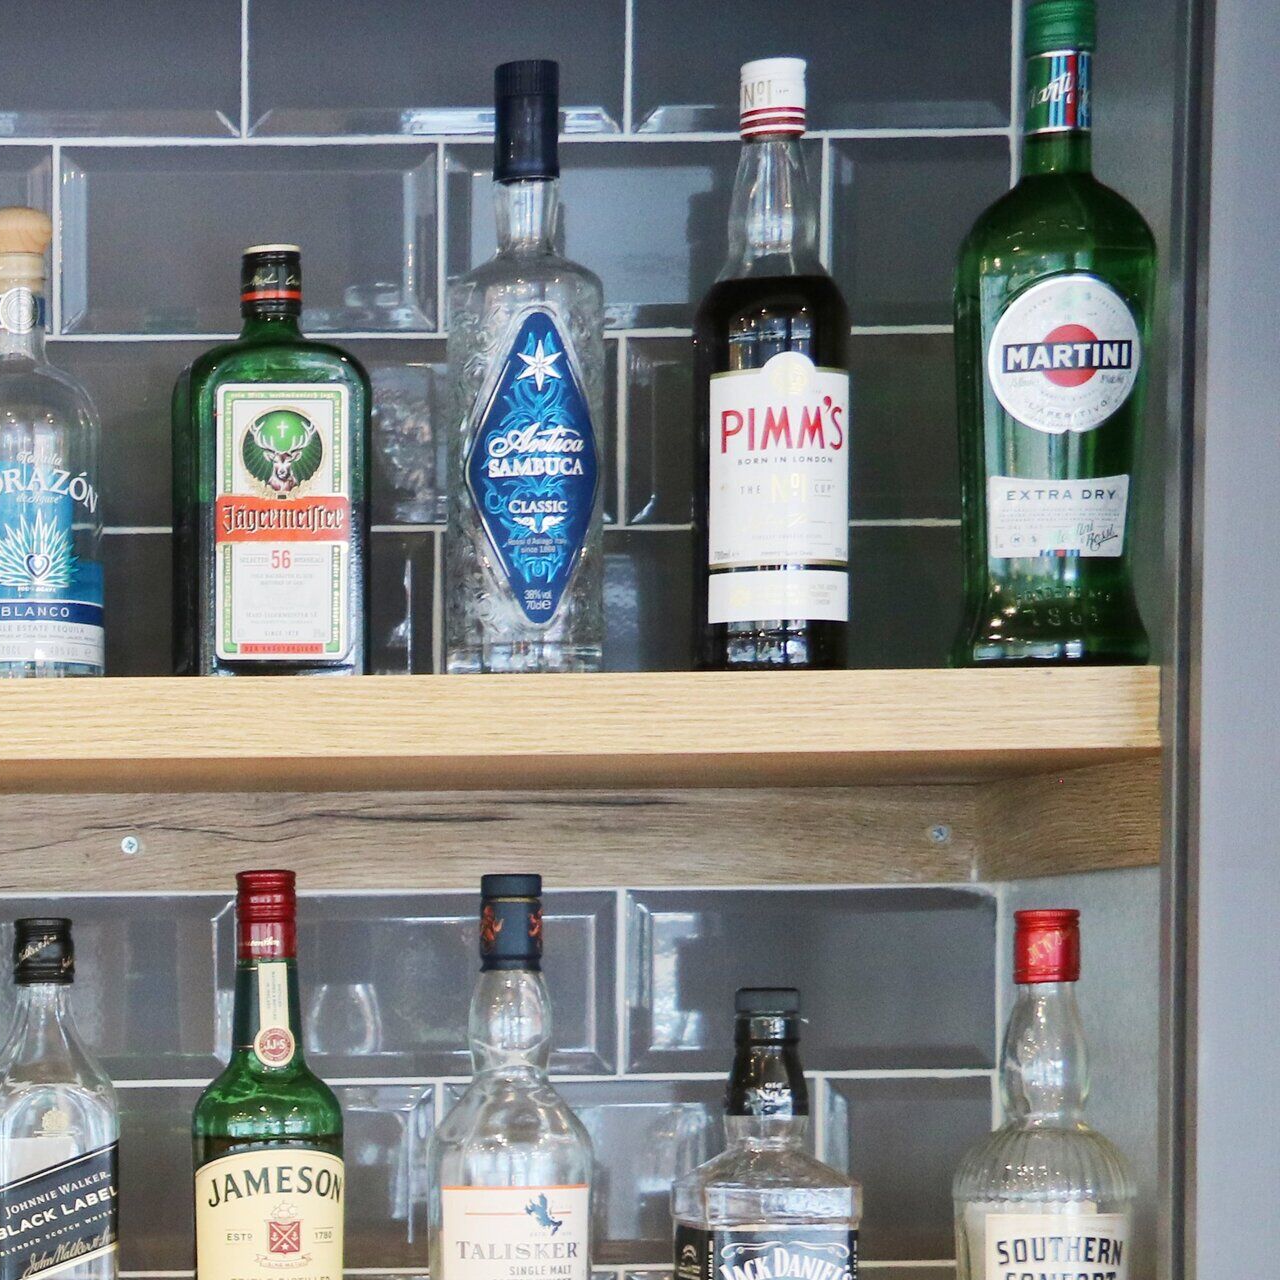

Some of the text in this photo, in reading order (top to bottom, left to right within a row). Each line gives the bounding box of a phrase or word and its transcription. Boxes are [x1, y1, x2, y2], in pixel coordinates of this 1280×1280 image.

[1006, 342, 1129, 372] MARTINI
[719, 395, 843, 454] PIMM'S
[488, 421, 585, 458] Antica
[16, 450, 63, 466] Tequila
[487, 456, 584, 478] SAMBUCA
[737, 456, 834, 466] BORN IN LONDON
[740, 484, 833, 495] THE CUP
[1006, 488, 1118, 501] EXTRA DRY
[507, 499, 569, 514] CLASSIC
[271, 550, 292, 569] 56
[0, 606, 70, 618] BLANCO
[52, 624, 85, 634] TEQUILA
[4, 1171, 109, 1220] JOHNNIE WALKER
[207, 1165, 341, 1208] JAMESON
[60, 1185, 118, 1216] LABEL
[0, 1222, 80, 1257] BLENDED SCOTCH
[313, 1230, 333, 1240] 1780
[455, 1240, 579, 1261] TALISKER
[996, 1236, 1124, 1266] SOUTHERN
[509, 1264, 572, 1276] SINGLE MALT
